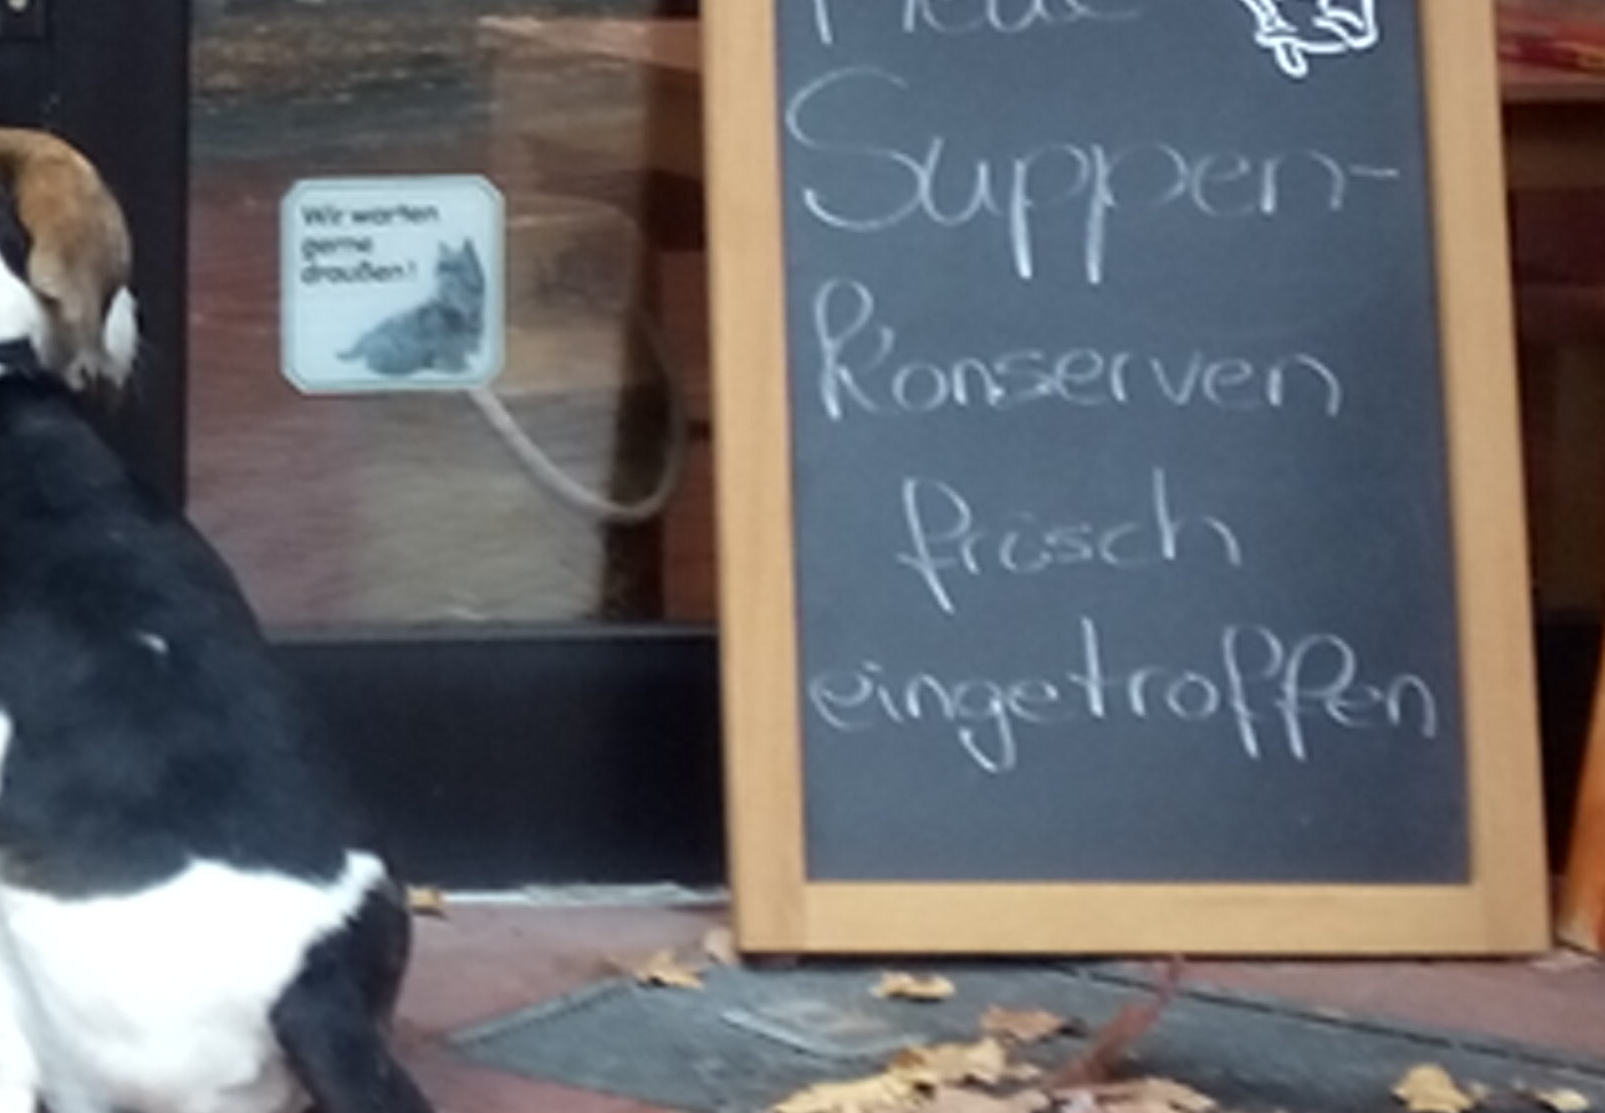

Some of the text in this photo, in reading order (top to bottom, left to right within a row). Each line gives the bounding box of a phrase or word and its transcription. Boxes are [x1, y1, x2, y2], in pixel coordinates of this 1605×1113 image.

[300, 204, 440, 226] Wir warten
[300, 236, 373, 262] gerne
[813, 276, 1342, 421] Konserven
[895, 465, 1243, 616] frisch
[806, 616, 1438, 774] eingetroffen
